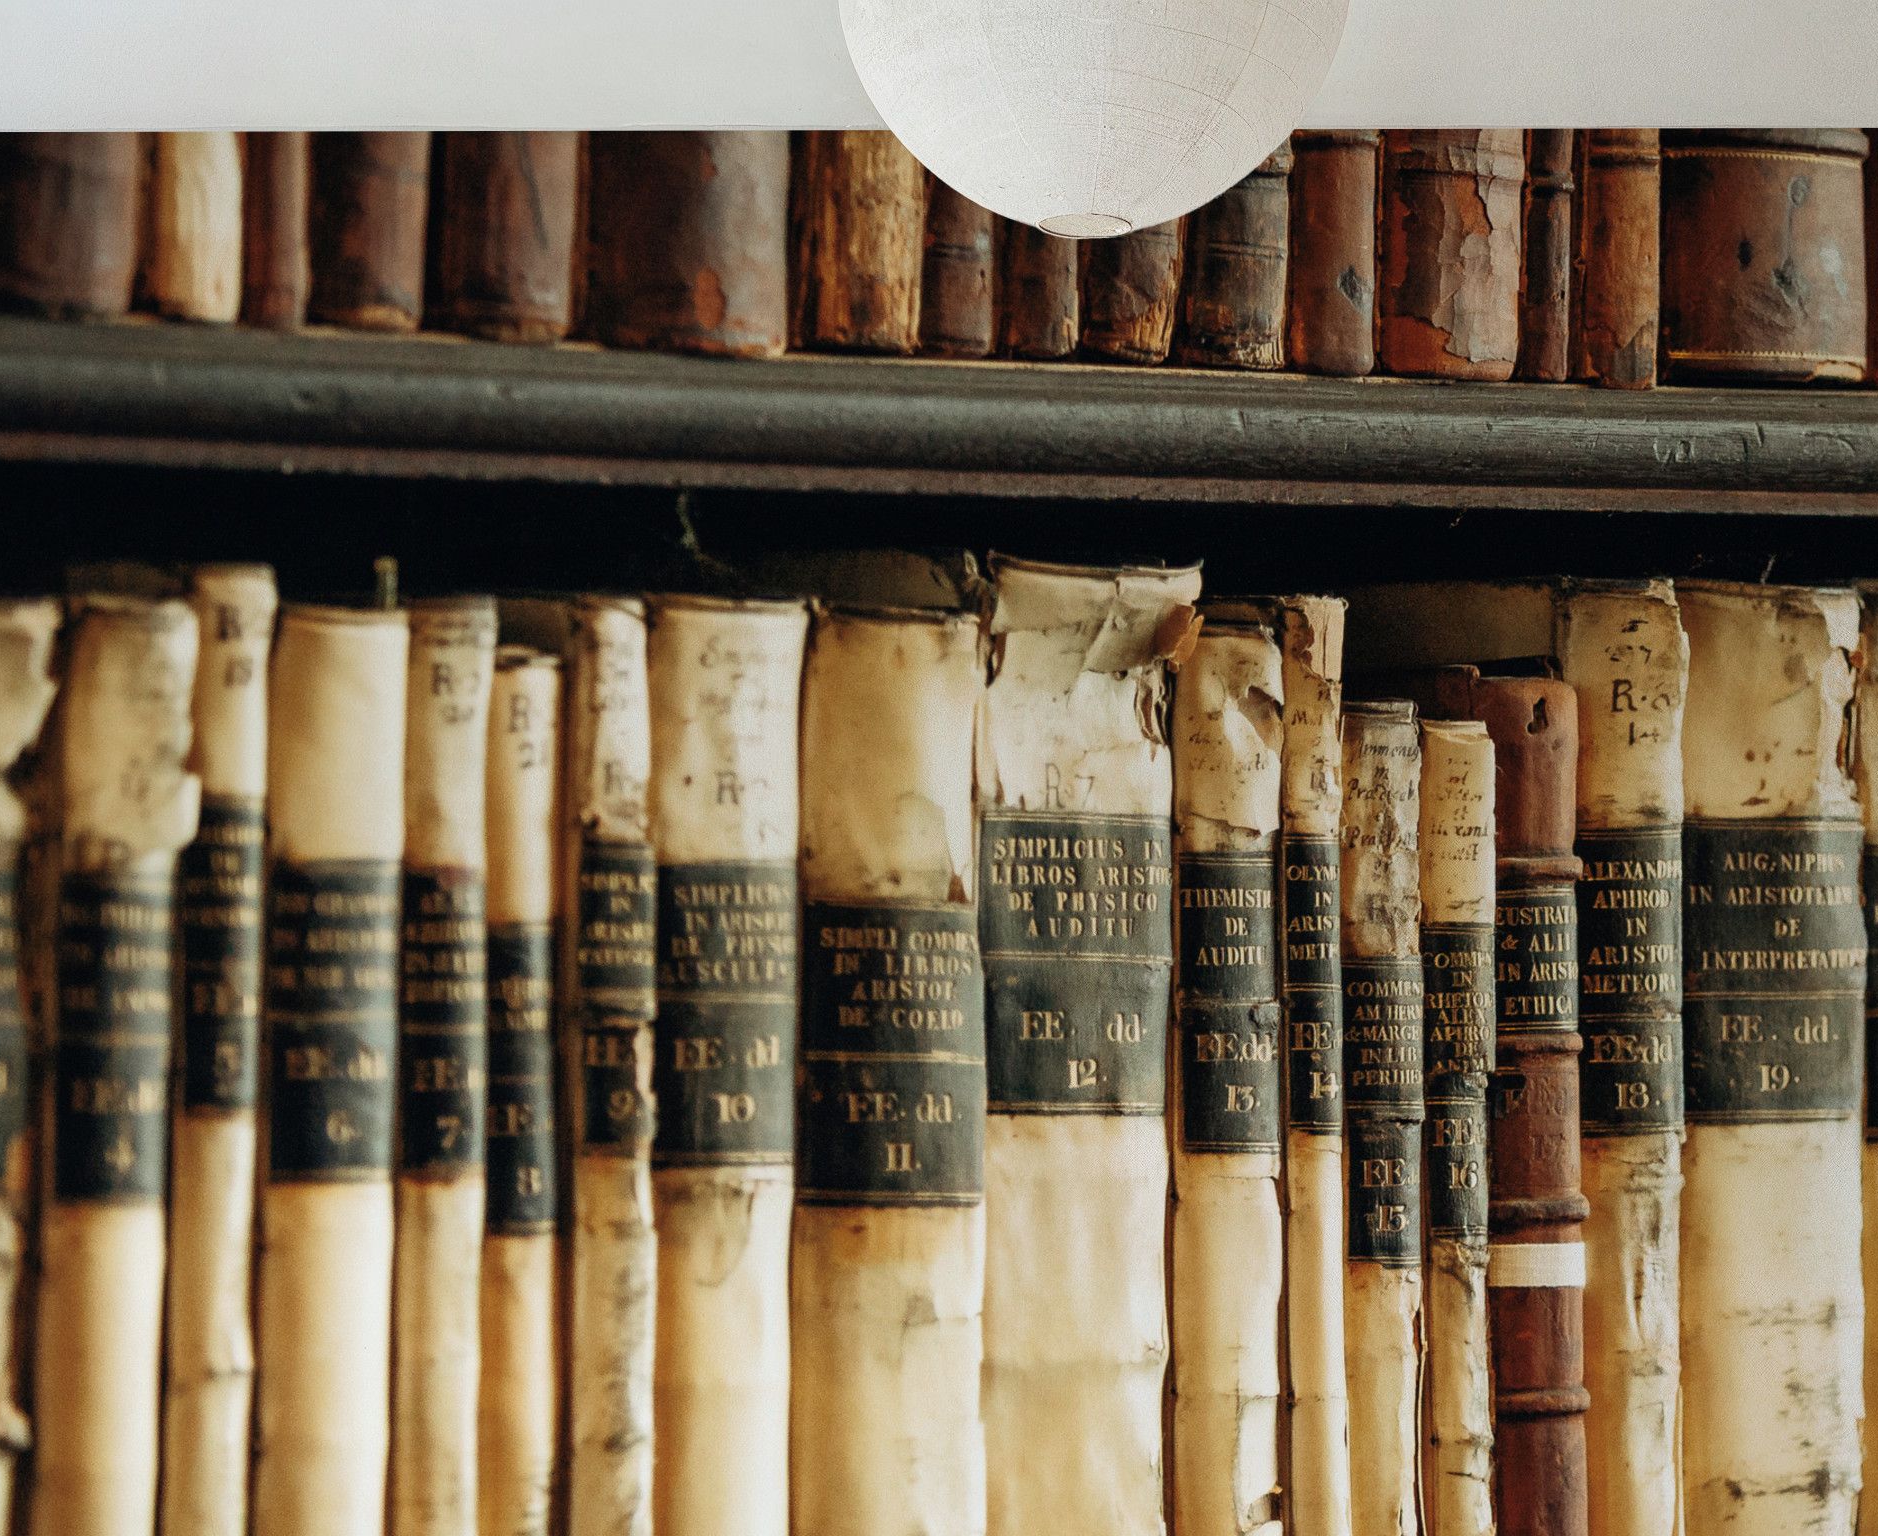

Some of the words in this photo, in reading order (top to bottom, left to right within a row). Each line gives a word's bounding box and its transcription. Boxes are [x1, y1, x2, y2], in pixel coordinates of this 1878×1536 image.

[993, 838, 1125, 861] SIMPLICIUS
[991, 864, 1080, 887] LIBROS
[1008, 891, 1035, 912] DE
[1055, 892, 1160, 914] PHYSICO
[1314, 890, 1333, 908] IN
[1689, 884, 1712, 905] IN
[1027, 916, 1137, 939] AUDITU
[1224, 916, 1249, 937] DE
[1626, 915, 1649, 938] IN
[1774, 918, 1802, 938] DE
[1501, 934, 1519, 951] &
[1498, 962, 1521, 981] IN
[714, 1092, 755, 1124] 10
